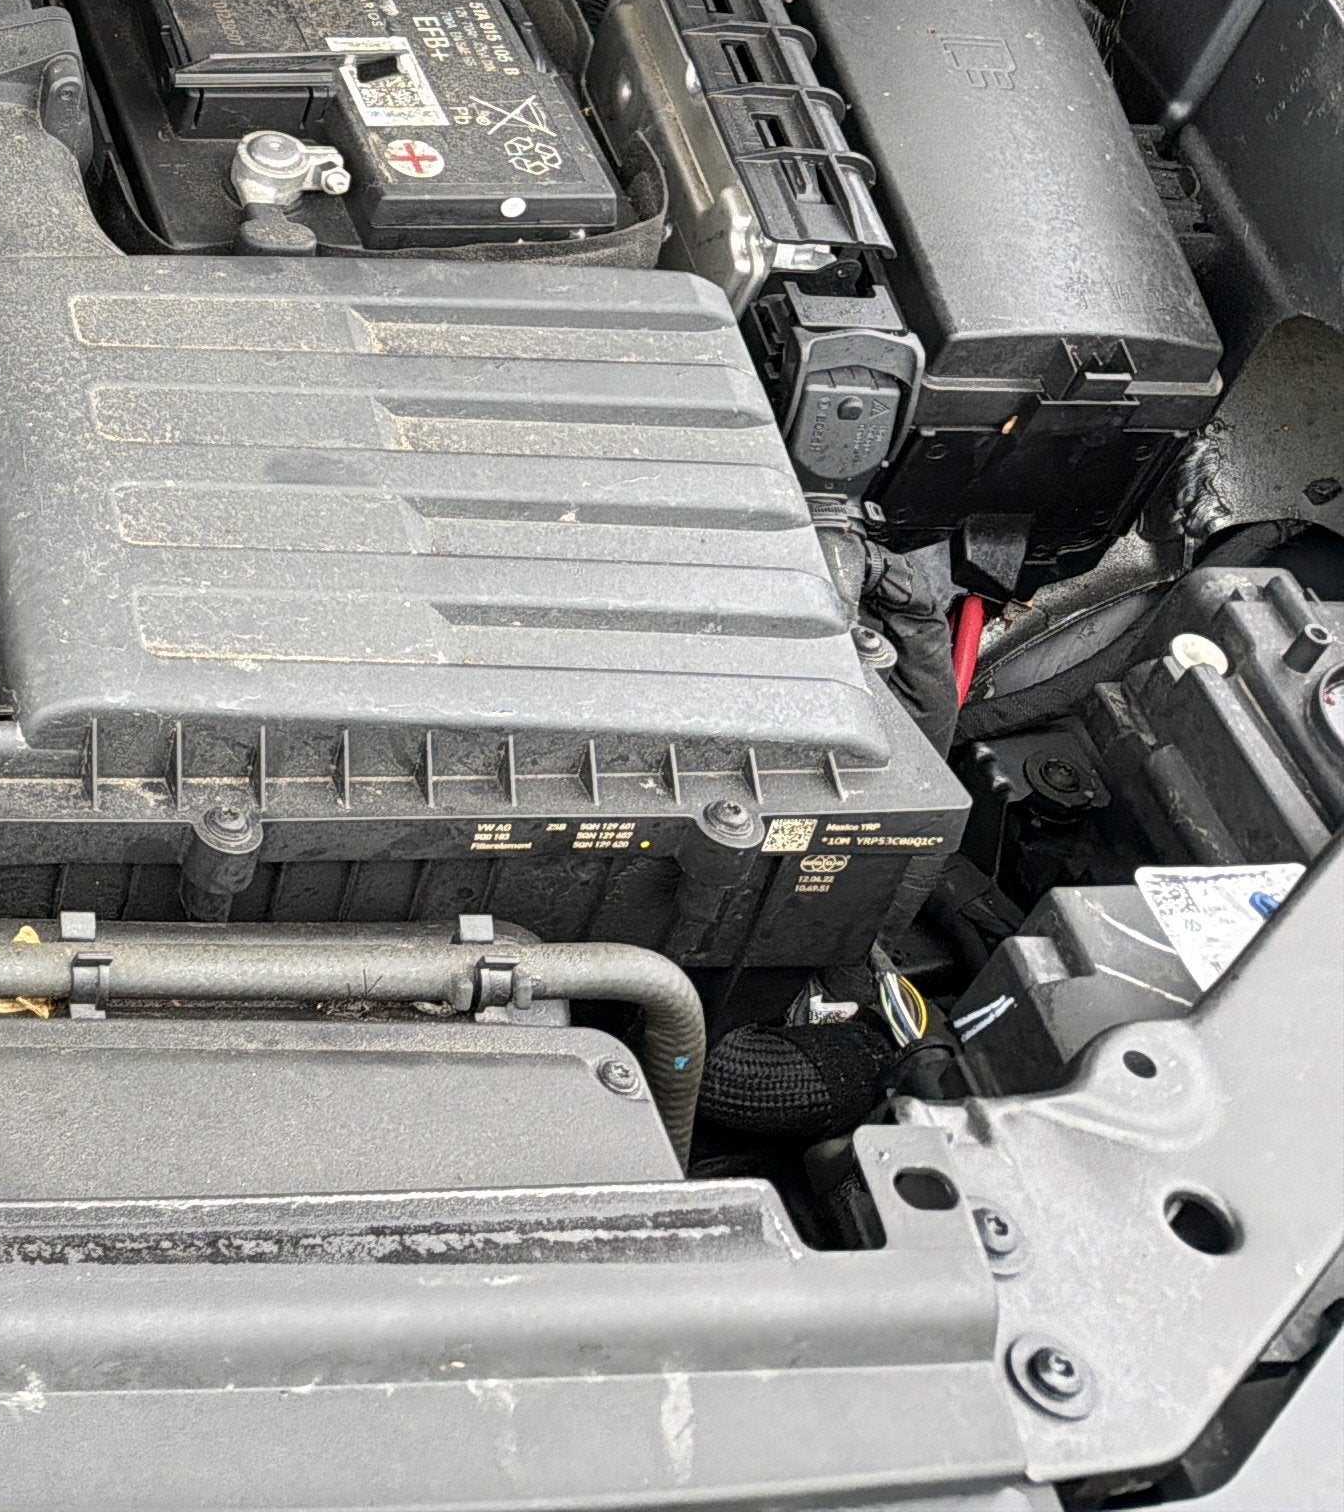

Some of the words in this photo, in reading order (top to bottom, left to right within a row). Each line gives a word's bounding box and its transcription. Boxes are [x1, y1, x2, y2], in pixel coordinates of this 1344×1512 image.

[467, 2, 491, 20] 5TA
[412, 15, 451, 61] EFB+
[478, 22, 503, 41] 915
[449, 107, 473, 125] Pb
